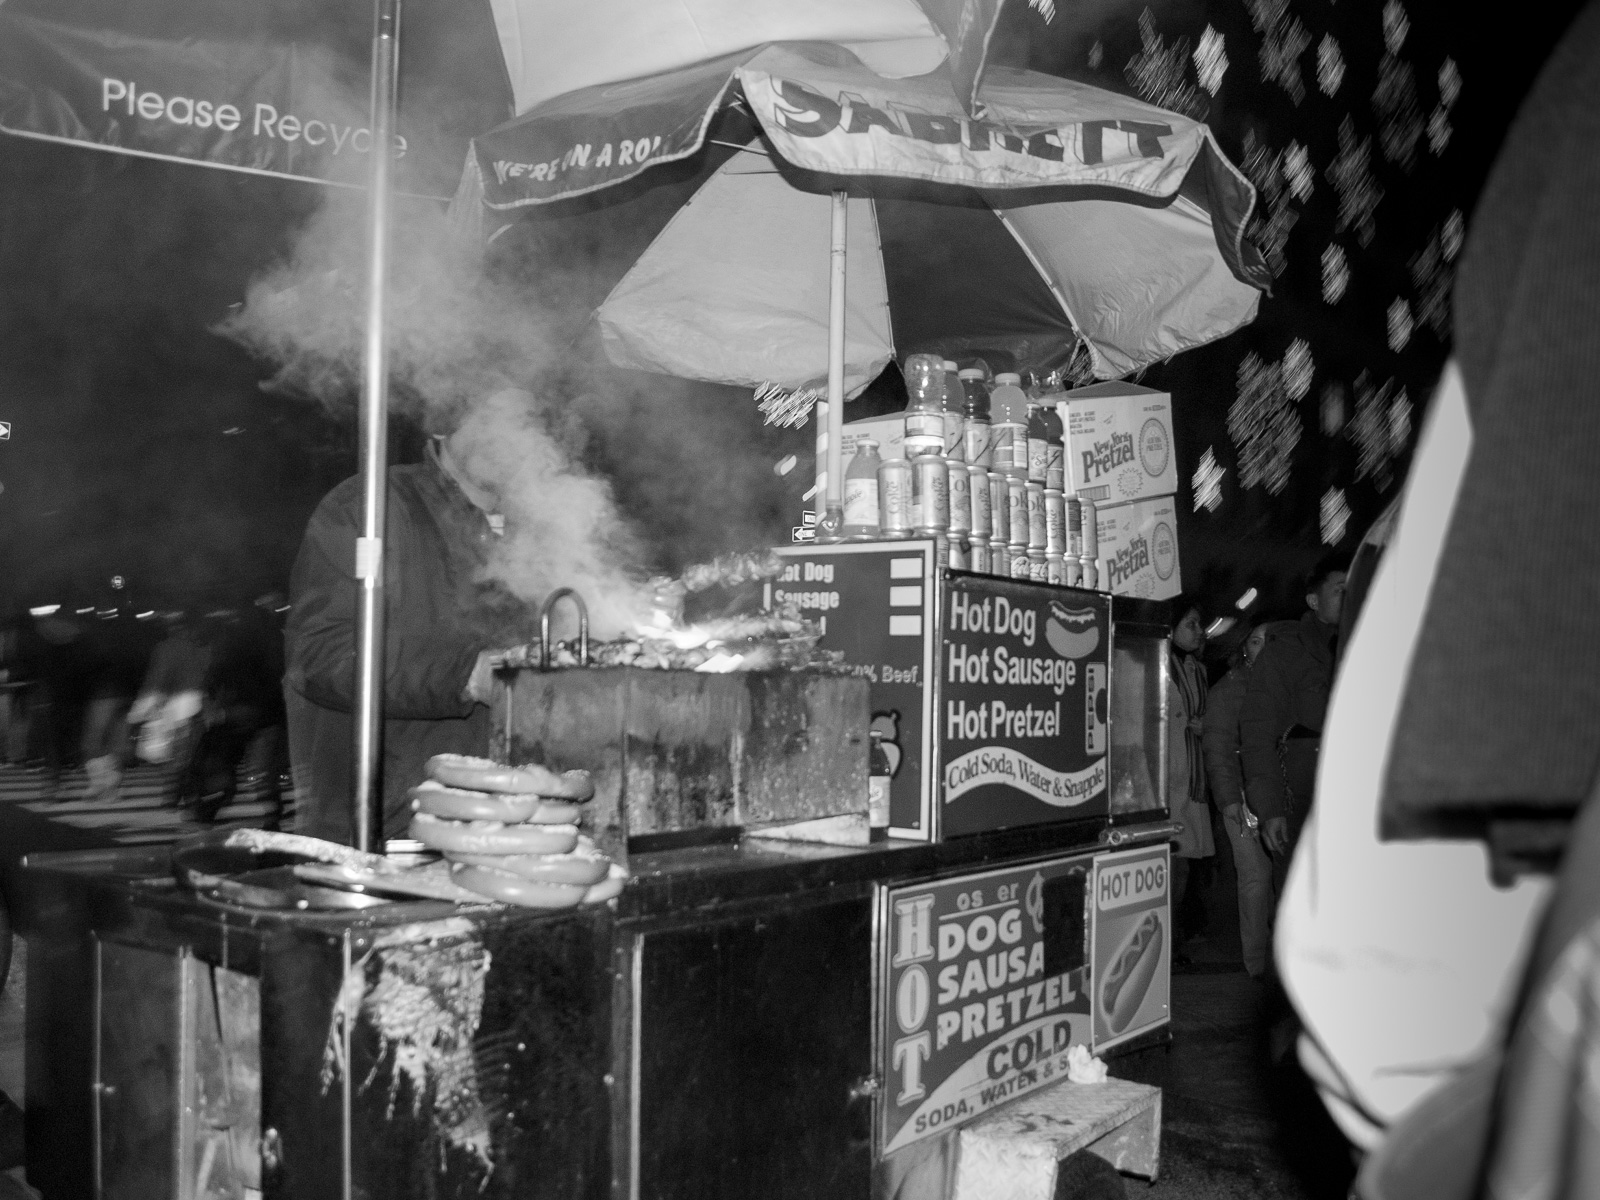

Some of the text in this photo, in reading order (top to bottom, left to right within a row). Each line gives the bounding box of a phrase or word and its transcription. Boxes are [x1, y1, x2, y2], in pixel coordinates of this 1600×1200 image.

[103, 77, 407, 159] Please Recyce
[595, 143, 612, 167] A
[1081, 433, 1135, 483] Pretzel
[1094, 438, 1110, 456] New
[1111, 431, 1130, 447] York
[777, 562, 834, 583] ot Dog
[1107, 539, 1149, 590] Pretzel
[775, 589, 840, 611] Sausage
[951, 591, 1036, 646] Hot Dog
[882, 665, 918, 683] Beef
[948, 644, 1076, 695] Hot Sausage
[947, 700, 1060, 739] Hot Pretzel
[949, 753, 1105, 799] Cold Soda, Water & Snapple
[1101, 864, 1164, 901] HOT DOG
[938, 908, 1021, 962] DOG
[937, 941, 1044, 1005] SAUSA
[893, 893, 935, 1107] HOT
[937, 973, 1076, 1050] PRETZEL
[987, 1020, 1072, 1080] COLD
[914, 1099, 974, 1134] SODA,
[981, 1070, 1037, 1105] WATER
[1043, 1062, 1053, 1078] &
